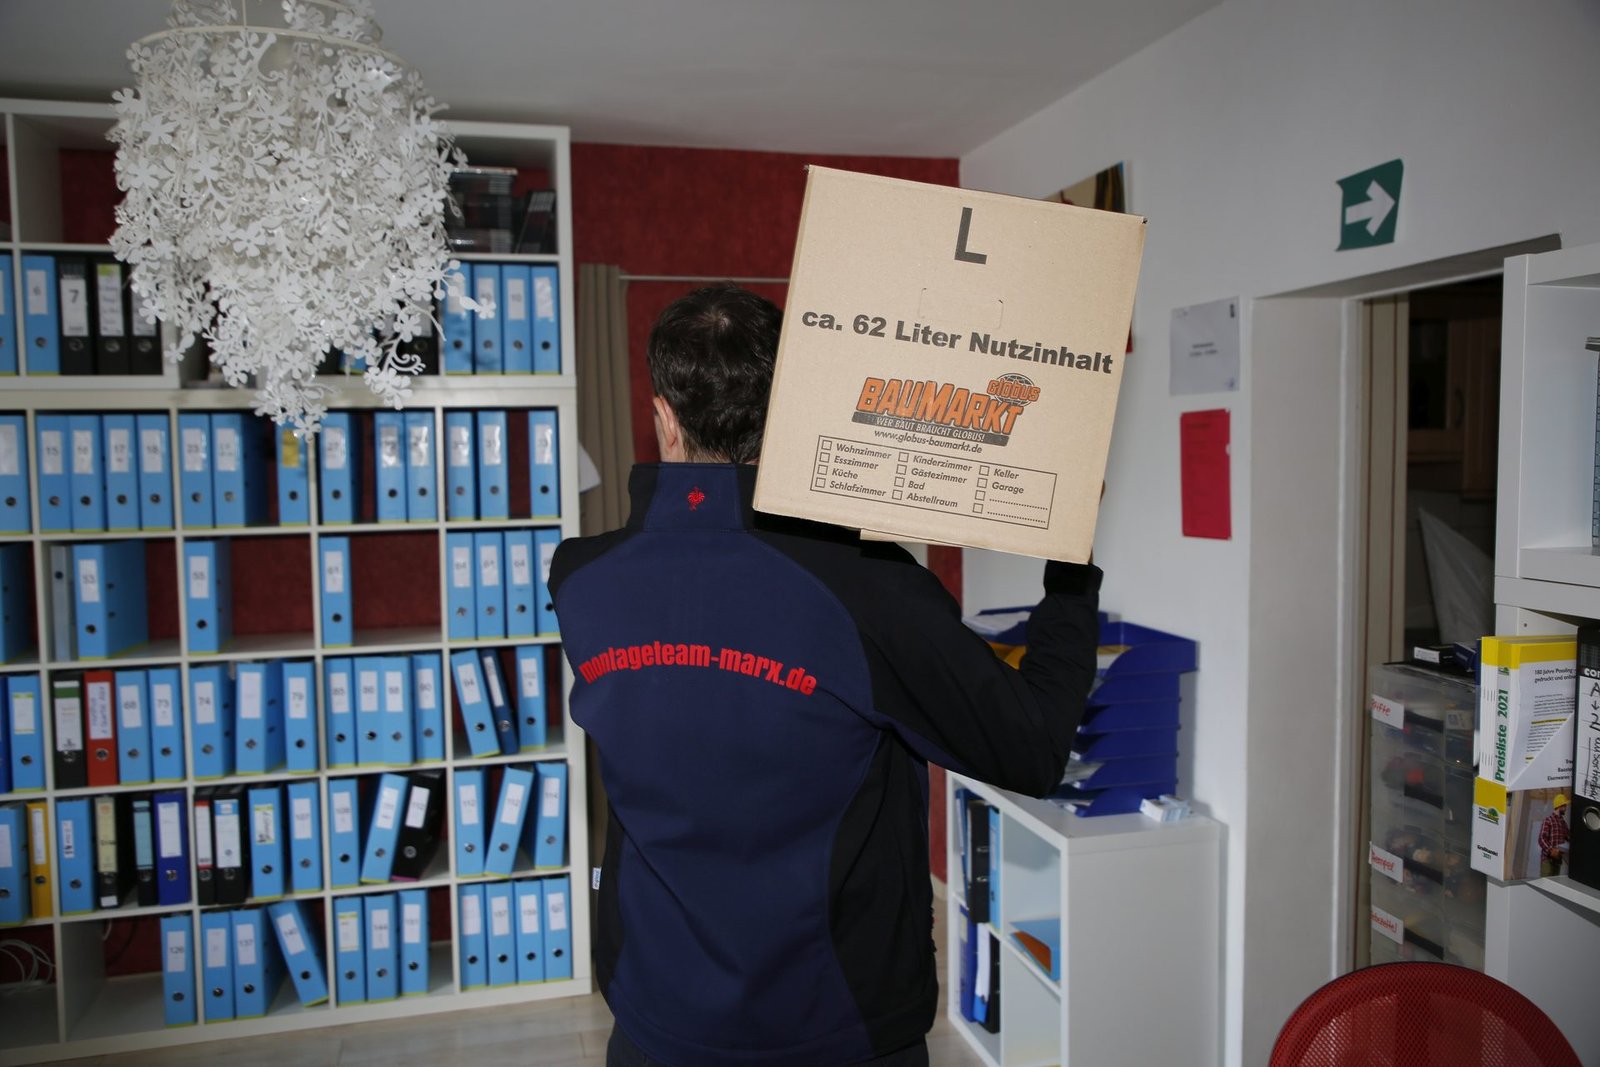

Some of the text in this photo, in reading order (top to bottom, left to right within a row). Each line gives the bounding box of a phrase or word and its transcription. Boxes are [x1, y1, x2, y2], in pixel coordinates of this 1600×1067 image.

[954, 207, 987, 265] L
[68, 289, 79, 304] 7
[801, 309, 1114, 374] ca. 62 Liter Nutzinhalt
[856, 377, 1024, 435] BAUMARKT
[875, 417, 986, 442] WER BAUT BRAUCHT GLOBUS!
[874, 429, 983, 454] www.globus-baumarkt.de
[836, 443, 892, 459] Wohnzimmer
[834, 456, 879, 470] Esszimmer
[913, 455, 972, 472] Kinderzimmer
[832, 468, 858, 480] Küche
[911, 468, 967, 484] Gästezimmer
[994, 469, 1019, 480] Keller
[829, 481, 886, 497] Schlafzimmer
[908, 480, 925, 490] Bad
[992, 482, 1024, 494] Garage
[906, 493, 958, 508] Abstellraum
[578, 640, 817, 696] montageteam-marx.de
[1498, 689, 1509, 719] 2021
[1495, 724, 1507, 782] Preisliste
